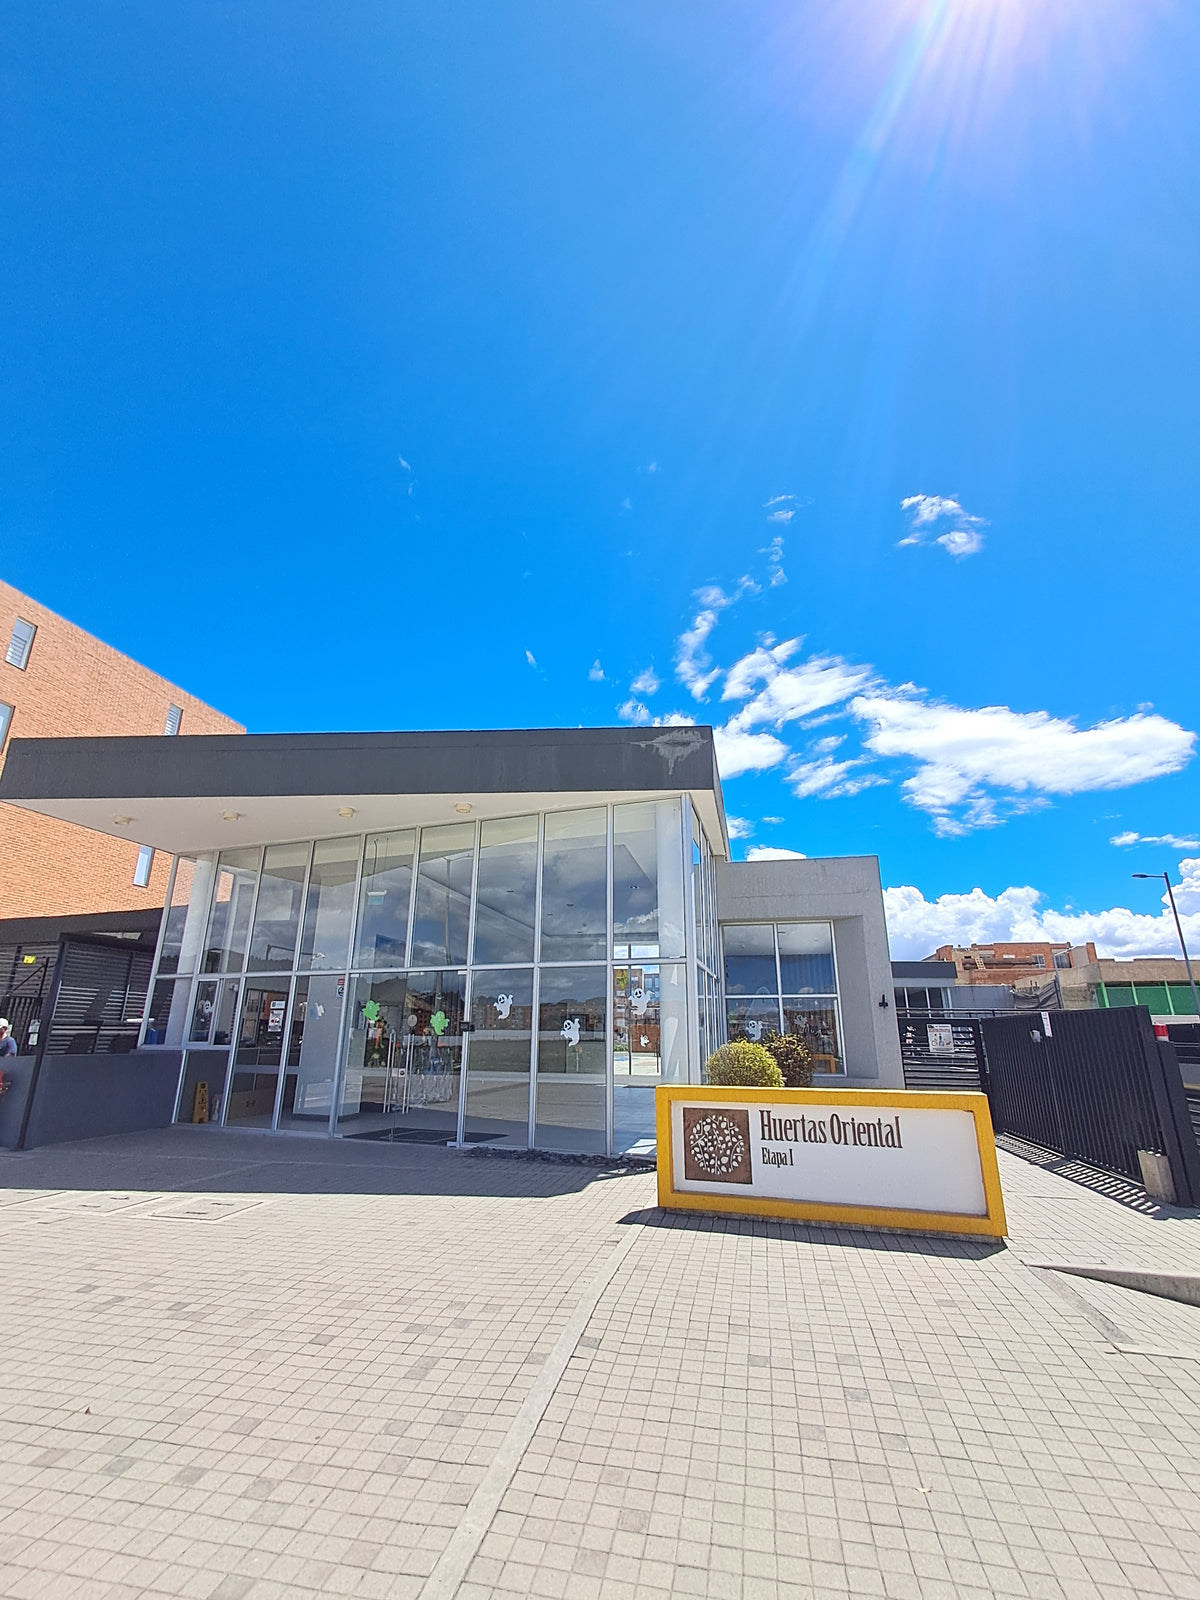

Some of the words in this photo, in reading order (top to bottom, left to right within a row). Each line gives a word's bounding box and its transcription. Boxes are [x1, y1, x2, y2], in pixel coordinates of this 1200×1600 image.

[759, 1109, 828, 1144] Huertas
[829, 1113, 904, 1149] Oriental
[761, 1147, 788, 1169] Etapa
